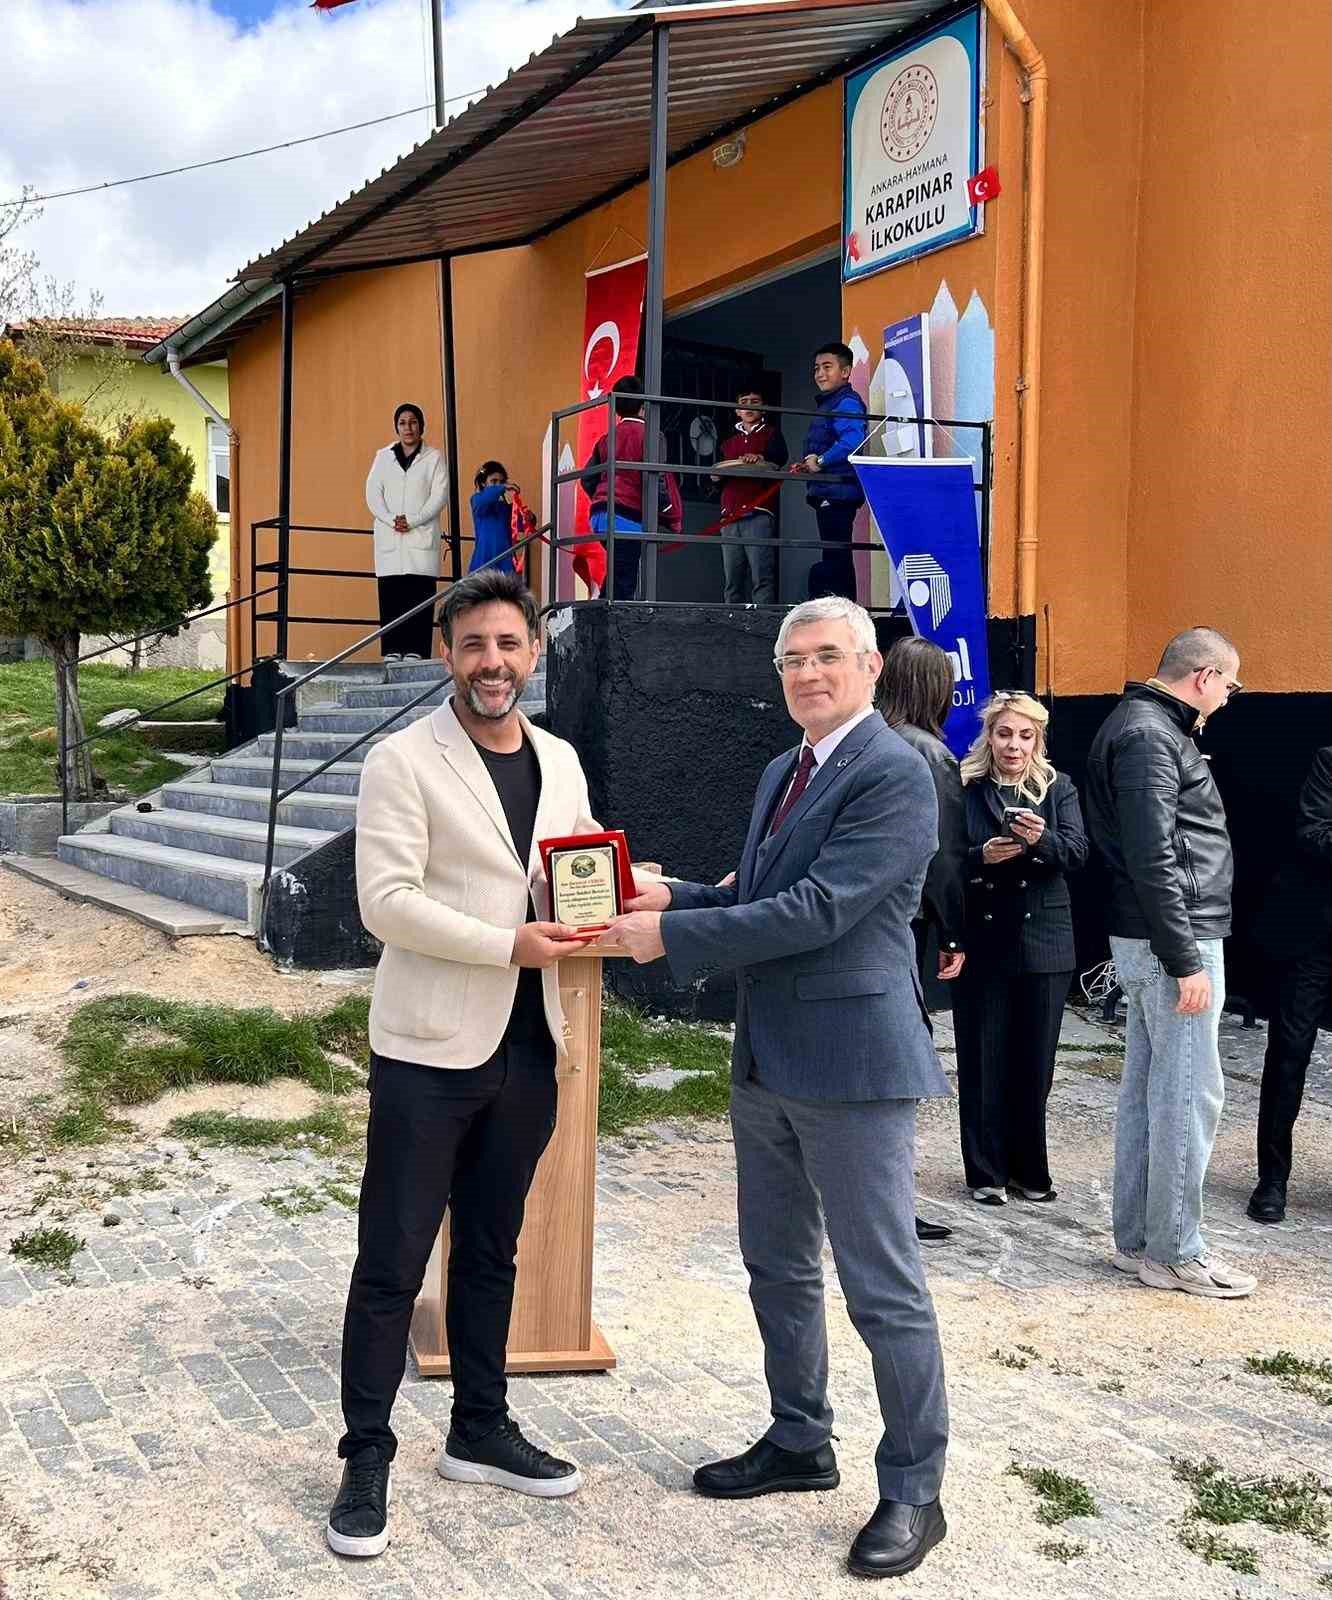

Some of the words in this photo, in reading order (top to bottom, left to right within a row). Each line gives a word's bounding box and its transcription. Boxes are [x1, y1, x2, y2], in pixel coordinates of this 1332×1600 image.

[865, 171, 953, 226] KARAPINAR
[870, 153, 948, 196] ANKARA-HAYMANA
[871, 204, 945, 252] İLKOKULU
